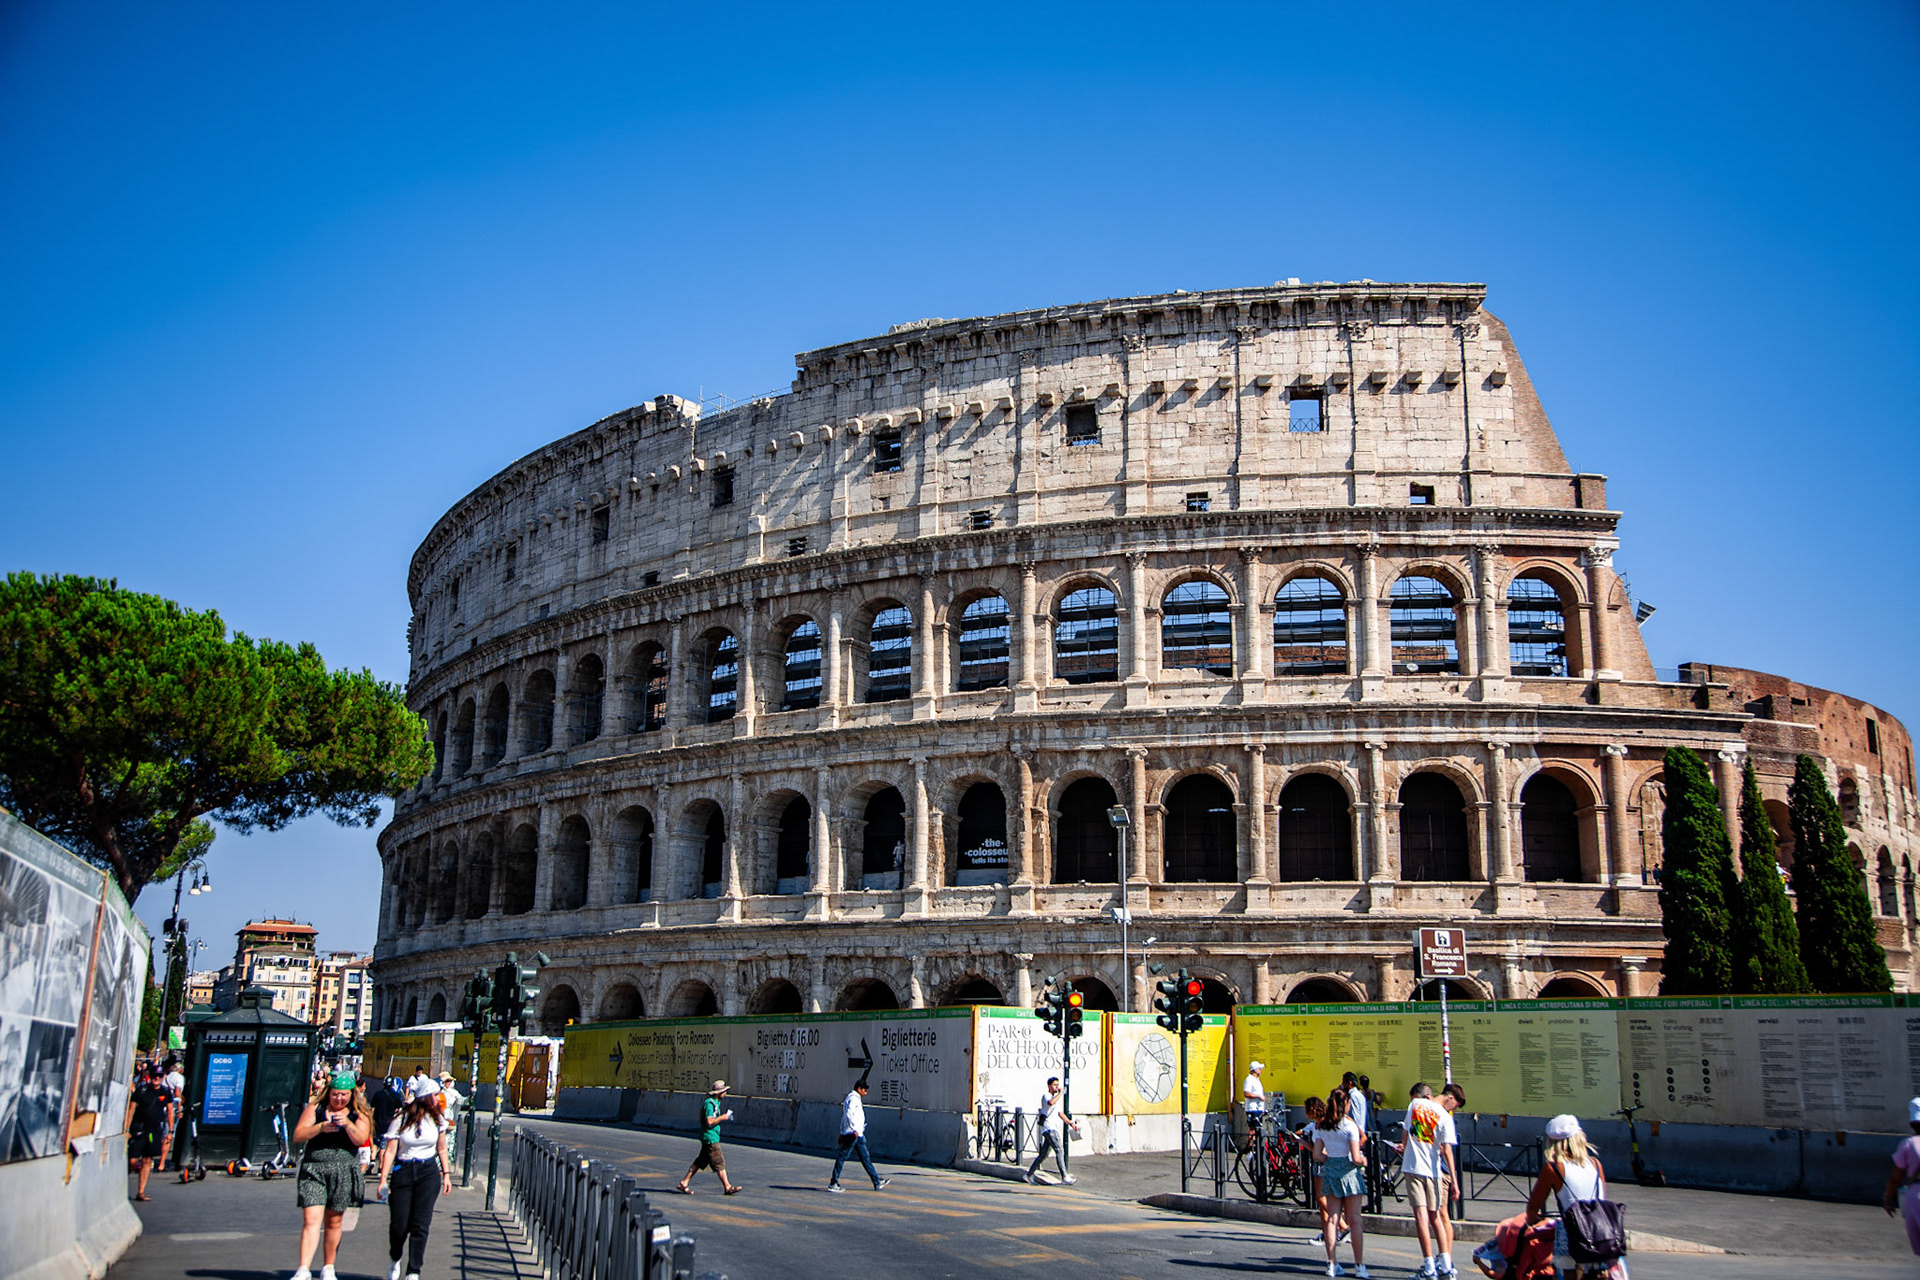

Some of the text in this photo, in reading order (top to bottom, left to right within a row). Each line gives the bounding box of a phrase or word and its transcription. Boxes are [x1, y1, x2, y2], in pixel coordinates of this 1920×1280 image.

[985, 838, 1001, 847] the
[967, 847, 1008, 857] colosseu
[1538, 1001, 1584, 1009] METROPOLITANA
[1740, 999, 1761, 1007] LINEA
[1790, 998, 1850, 1006] METROPOLITANA
[1860, 998, 1883, 1006] ROMA
[627, 1030, 715, 1047] Colosseo Palatino Foro Romano
[757, 1029, 788, 1050] Biglietto
[882, 1027, 937, 1051] Biglietterie
[687, 1050, 707, 1065] Roman
[708, 1049, 728, 1066] Forum
[757, 1051, 777, 1069] Ticket
[881, 1053, 940, 1073] Ticket Office
[988, 1054, 1087, 1069] DEL COLOSEO
